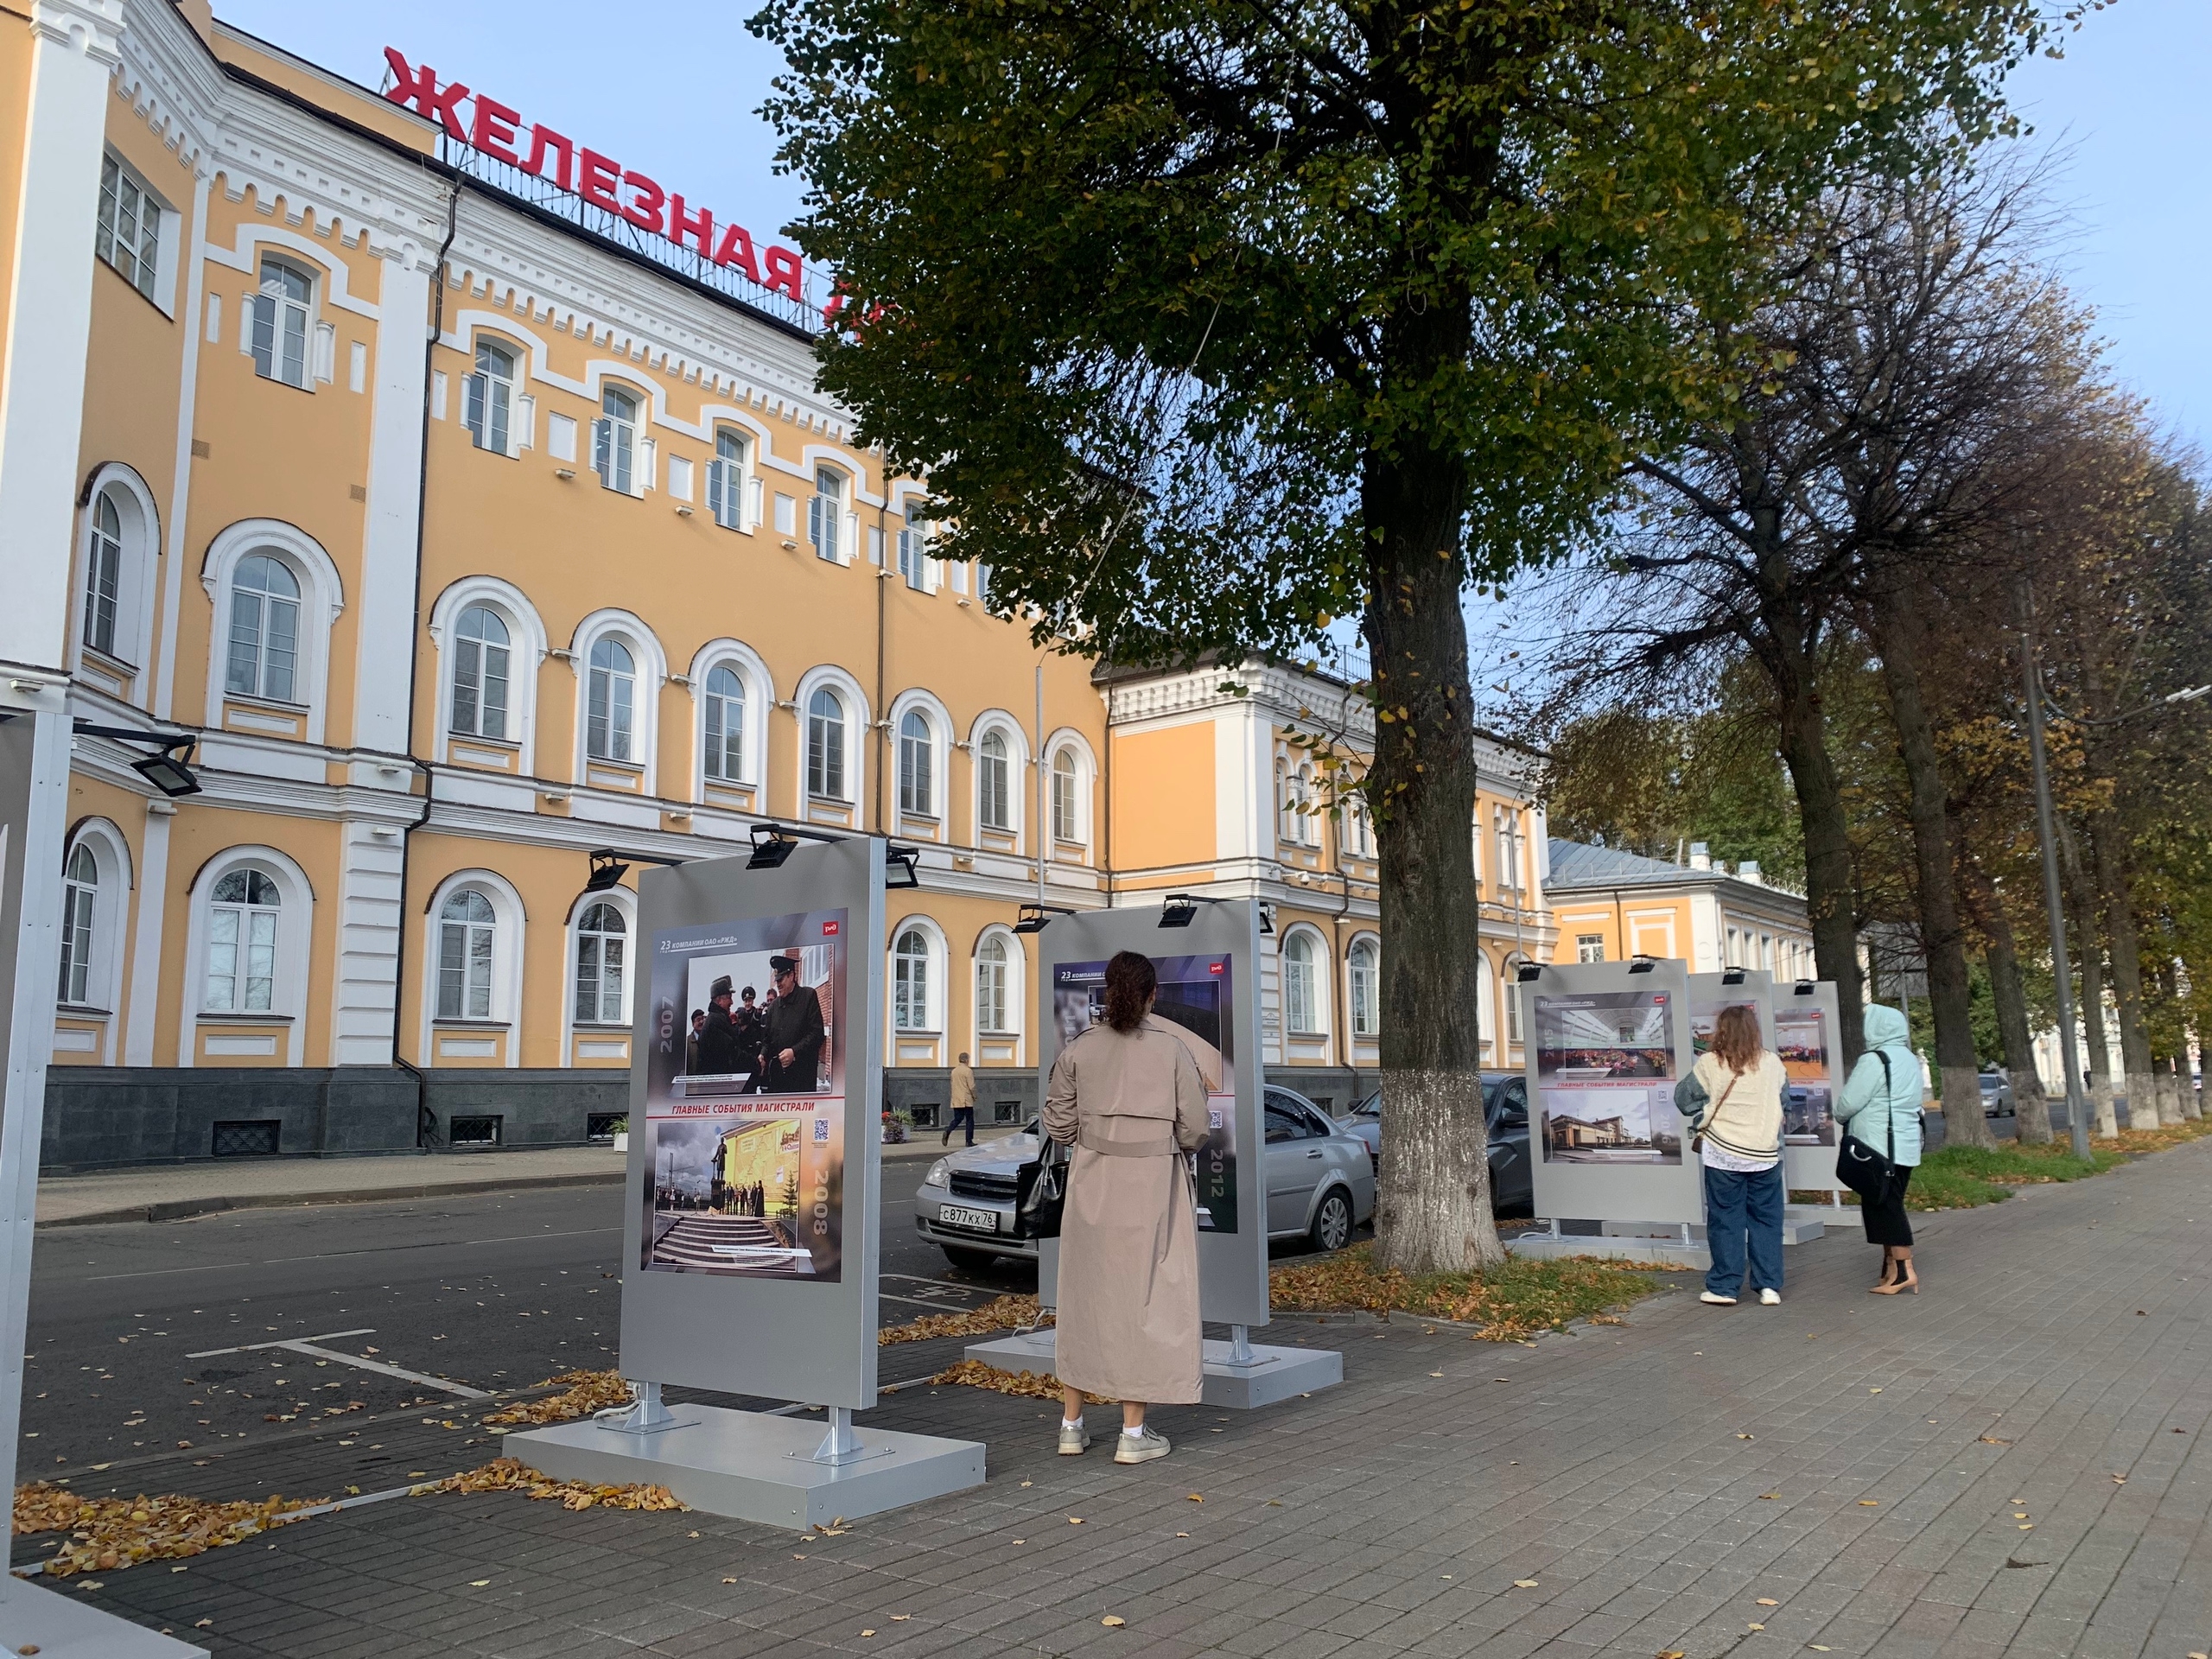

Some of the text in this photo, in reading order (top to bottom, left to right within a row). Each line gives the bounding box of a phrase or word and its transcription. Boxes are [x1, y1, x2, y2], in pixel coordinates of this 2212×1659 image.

[383, 45, 803, 302] ЖЕЛЕЗНАЯ
[660, 940, 671, 950] 23
[671, 939, 704, 949] КОМПАНИИ
[660, 996, 674, 1053] 2007
[1545, 1029, 1554, 1058] 2015
[671, 1102, 815, 1115] ГЛАВНЫЕ СОБЫТИЯ МАГИСТРАЛИ
[1660, 1114, 1672, 1144] 2016
[1211, 1149, 1224, 1198] 2012
[813, 1170, 829, 1236] 2008
